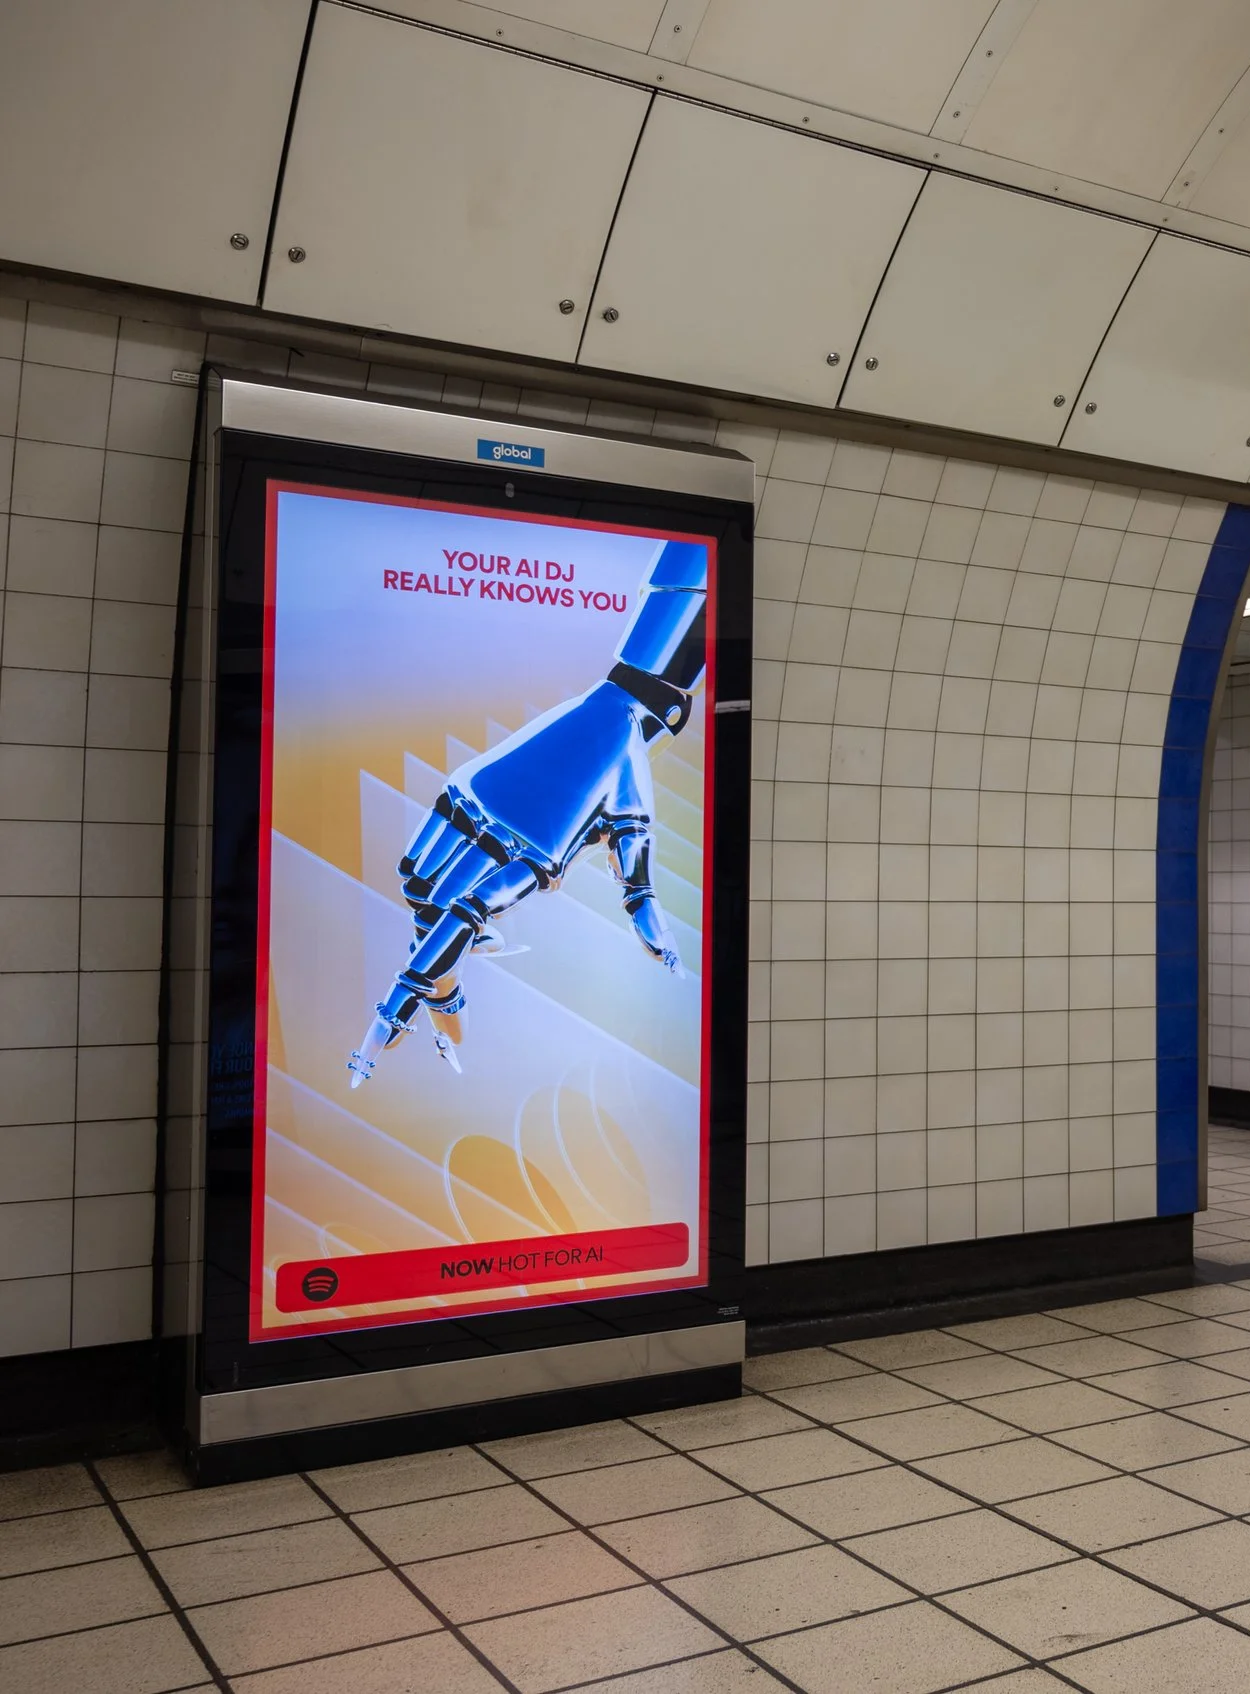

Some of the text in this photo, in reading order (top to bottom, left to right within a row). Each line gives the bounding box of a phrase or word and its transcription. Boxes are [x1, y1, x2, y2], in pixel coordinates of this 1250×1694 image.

[493, 444, 532, 460] global
[442, 549, 575, 583] YOUR AI DJ
[382, 569, 628, 613] REALLY KNOWS YOU
[440, 1244, 604, 1280] NOW HOT FOR AI
